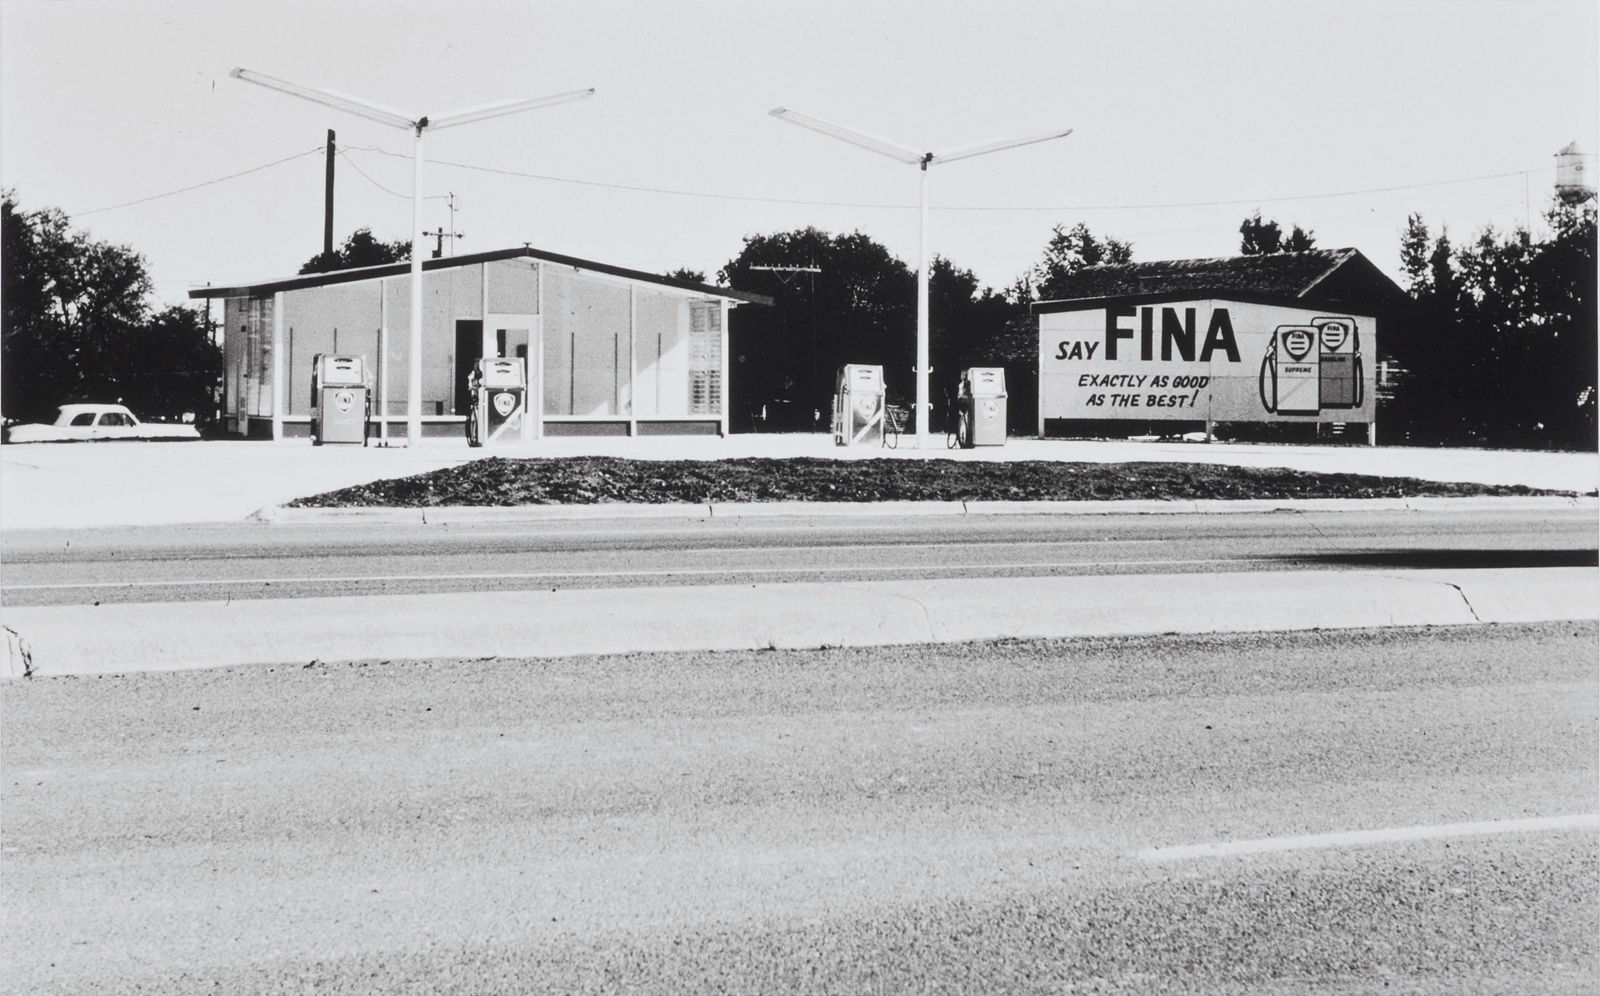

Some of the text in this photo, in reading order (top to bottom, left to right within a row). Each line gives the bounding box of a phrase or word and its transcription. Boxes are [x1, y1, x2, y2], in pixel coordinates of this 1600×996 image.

[1055, 307, 1242, 362] SAY FINA
[1078, 373, 1210, 389] EXACTLY AS GOOD
[1085, 388, 1199, 408] AS THE BEST!
